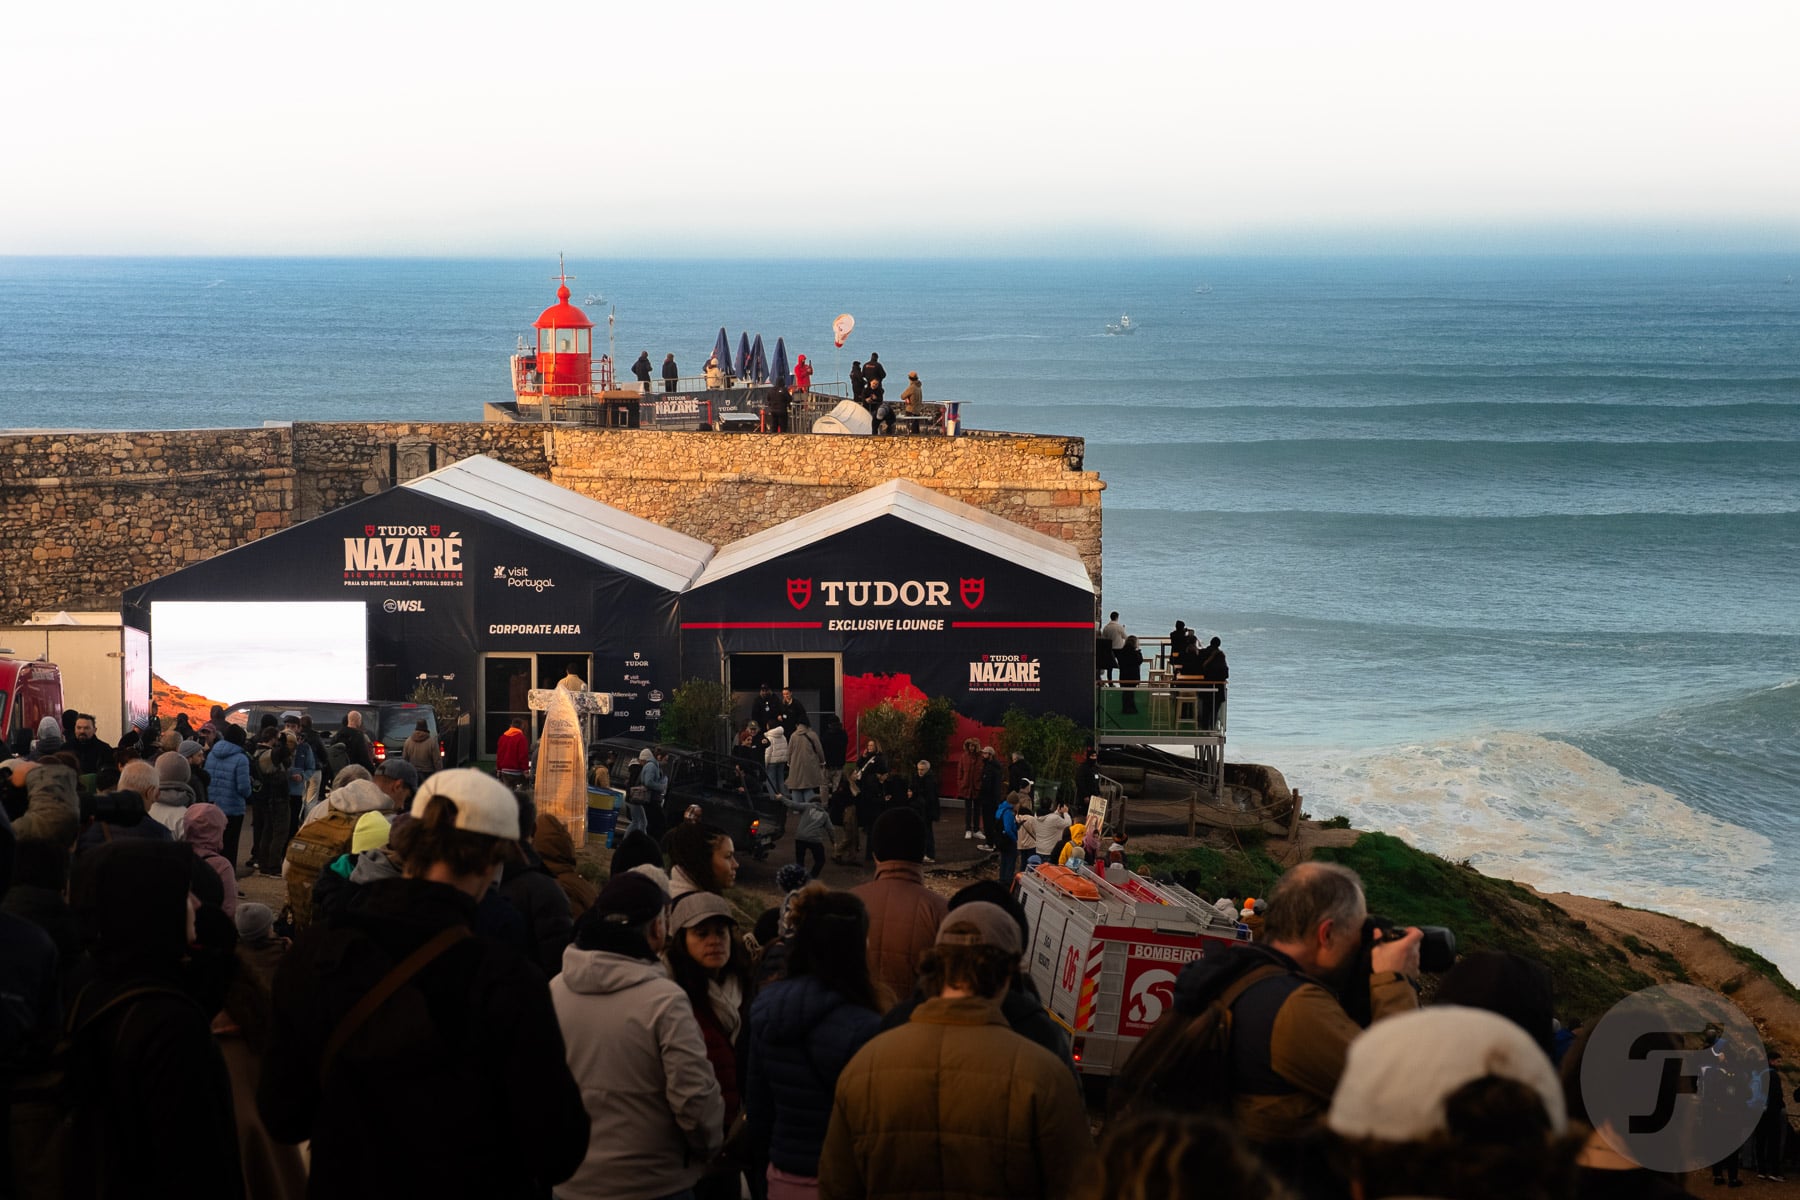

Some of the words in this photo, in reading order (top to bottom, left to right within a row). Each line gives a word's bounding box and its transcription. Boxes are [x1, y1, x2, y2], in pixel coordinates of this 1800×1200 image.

[655, 398, 700, 415] NAZARÉ
[377, 525, 428, 536] TUDOR
[343, 531, 463, 571] NAZARÉ
[508, 566, 529, 577] visit
[507, 577, 556, 593] Portugal
[820, 580, 952, 607] TUDOR
[396, 599, 426, 612] WSL
[489, 624, 552, 635] CORPORATE
[553, 624, 581, 635] AREA
[828, 619, 894, 631] EXCLUSIVE
[895, 619, 945, 631] LOUNGE
[989, 654, 1020, 662] TUDOR
[969, 658, 1041, 683] NAZARÉ
[1135, 944, 1205, 962] BOMBEIRO
[1062, 944, 1080, 993] 06
